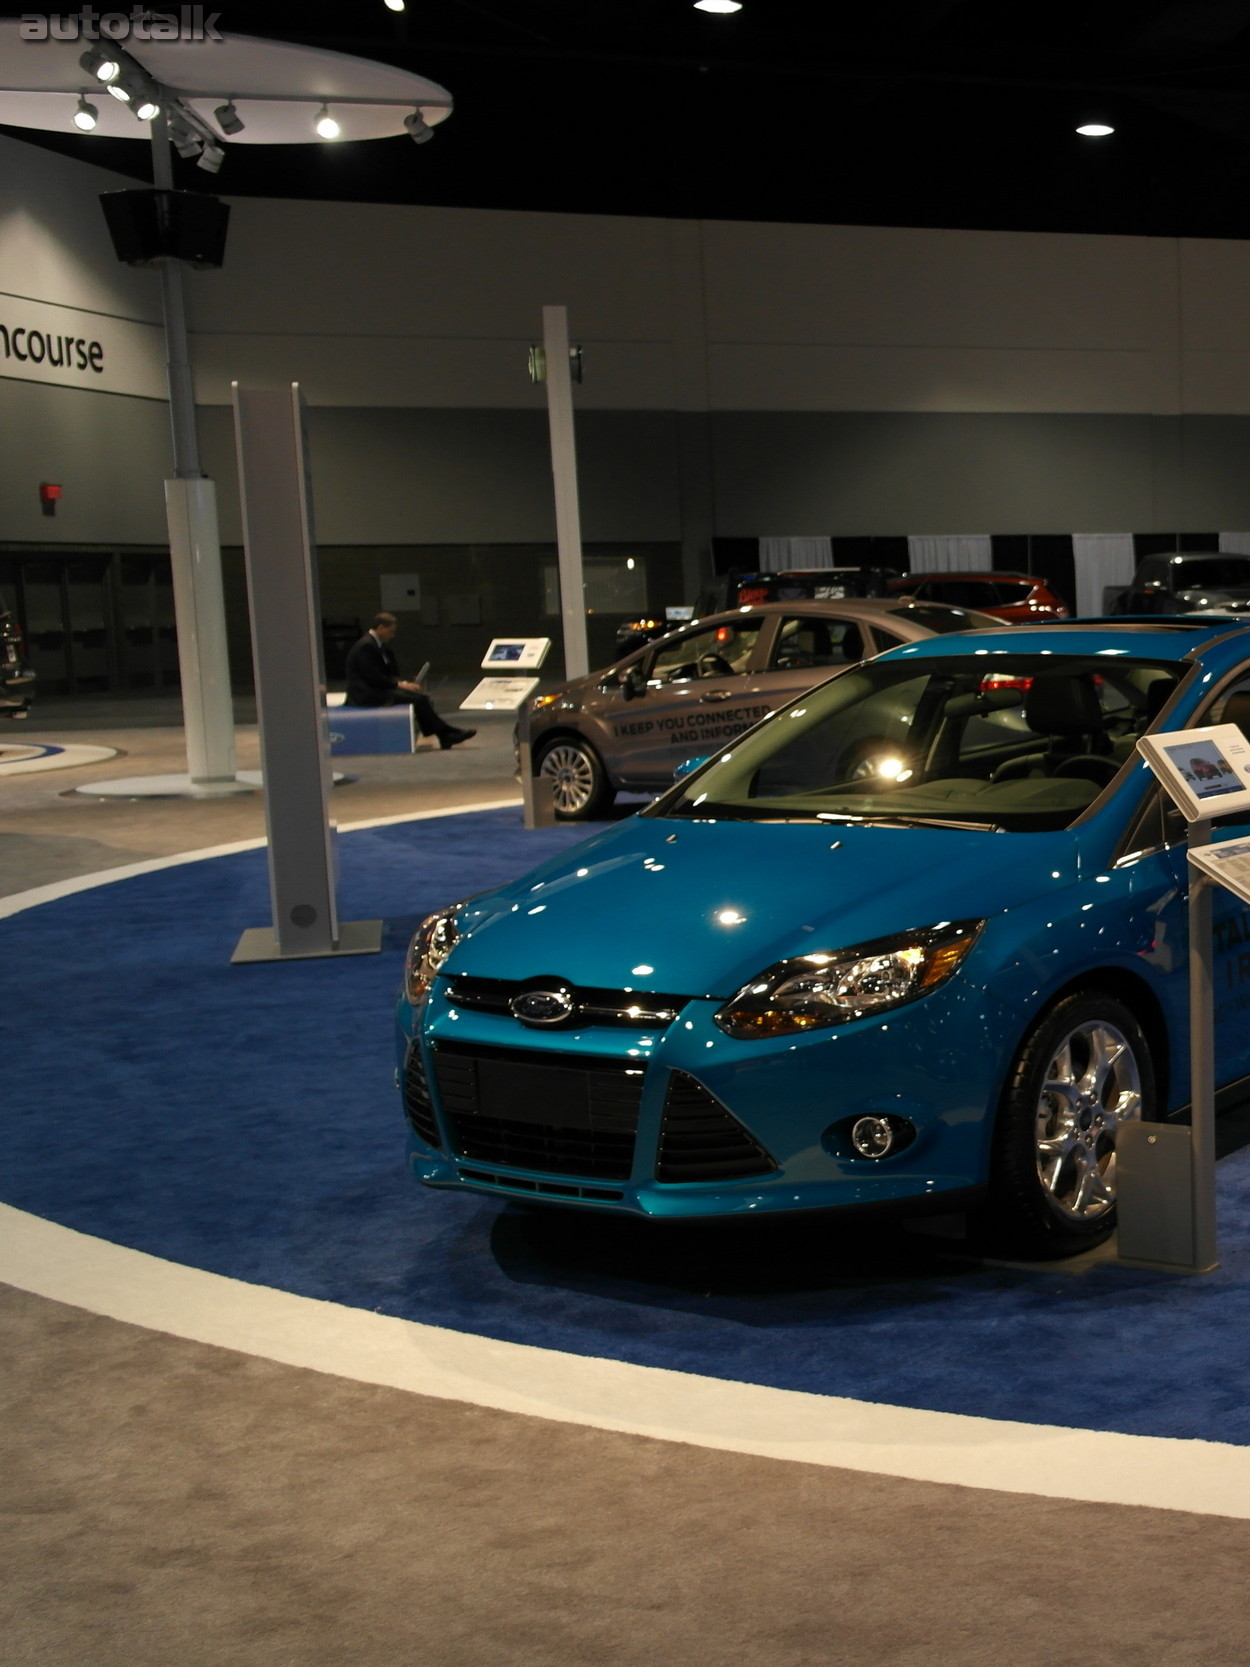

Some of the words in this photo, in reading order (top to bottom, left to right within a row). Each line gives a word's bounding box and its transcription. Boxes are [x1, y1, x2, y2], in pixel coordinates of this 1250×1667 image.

[620, 721, 654, 737] KEEP
[656, 717, 684, 732] YOU
[687, 704, 772, 726] CONNECTED
[670, 731, 699, 745] AND
